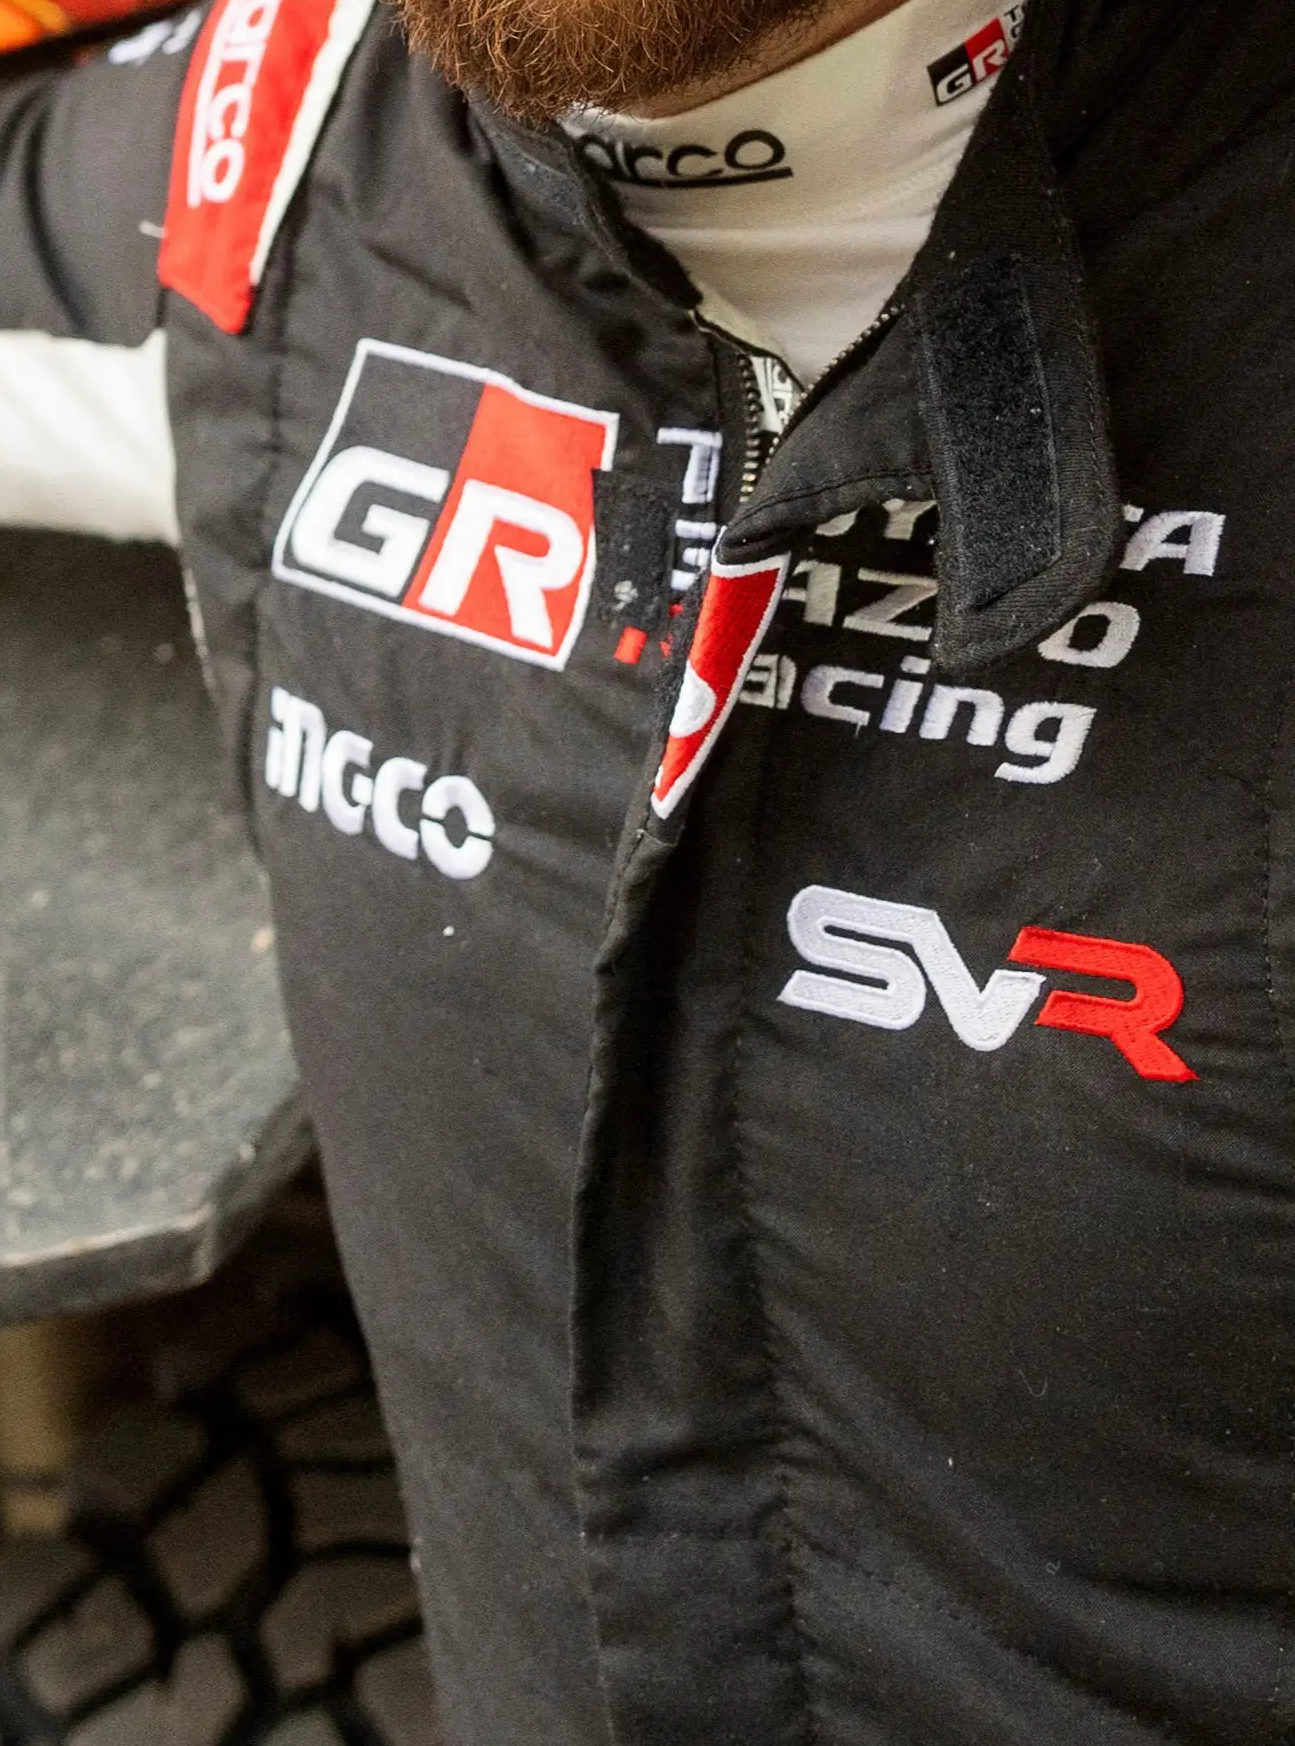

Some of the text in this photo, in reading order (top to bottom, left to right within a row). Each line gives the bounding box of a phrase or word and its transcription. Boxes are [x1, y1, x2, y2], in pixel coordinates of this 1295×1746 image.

[936, 38, 1006, 103] GR
[578, 129, 793, 188] arco
[291, 446, 585, 652] GR
[739, 654, 1097, 784] acing
[777, 884, 1199, 1083] SVR
